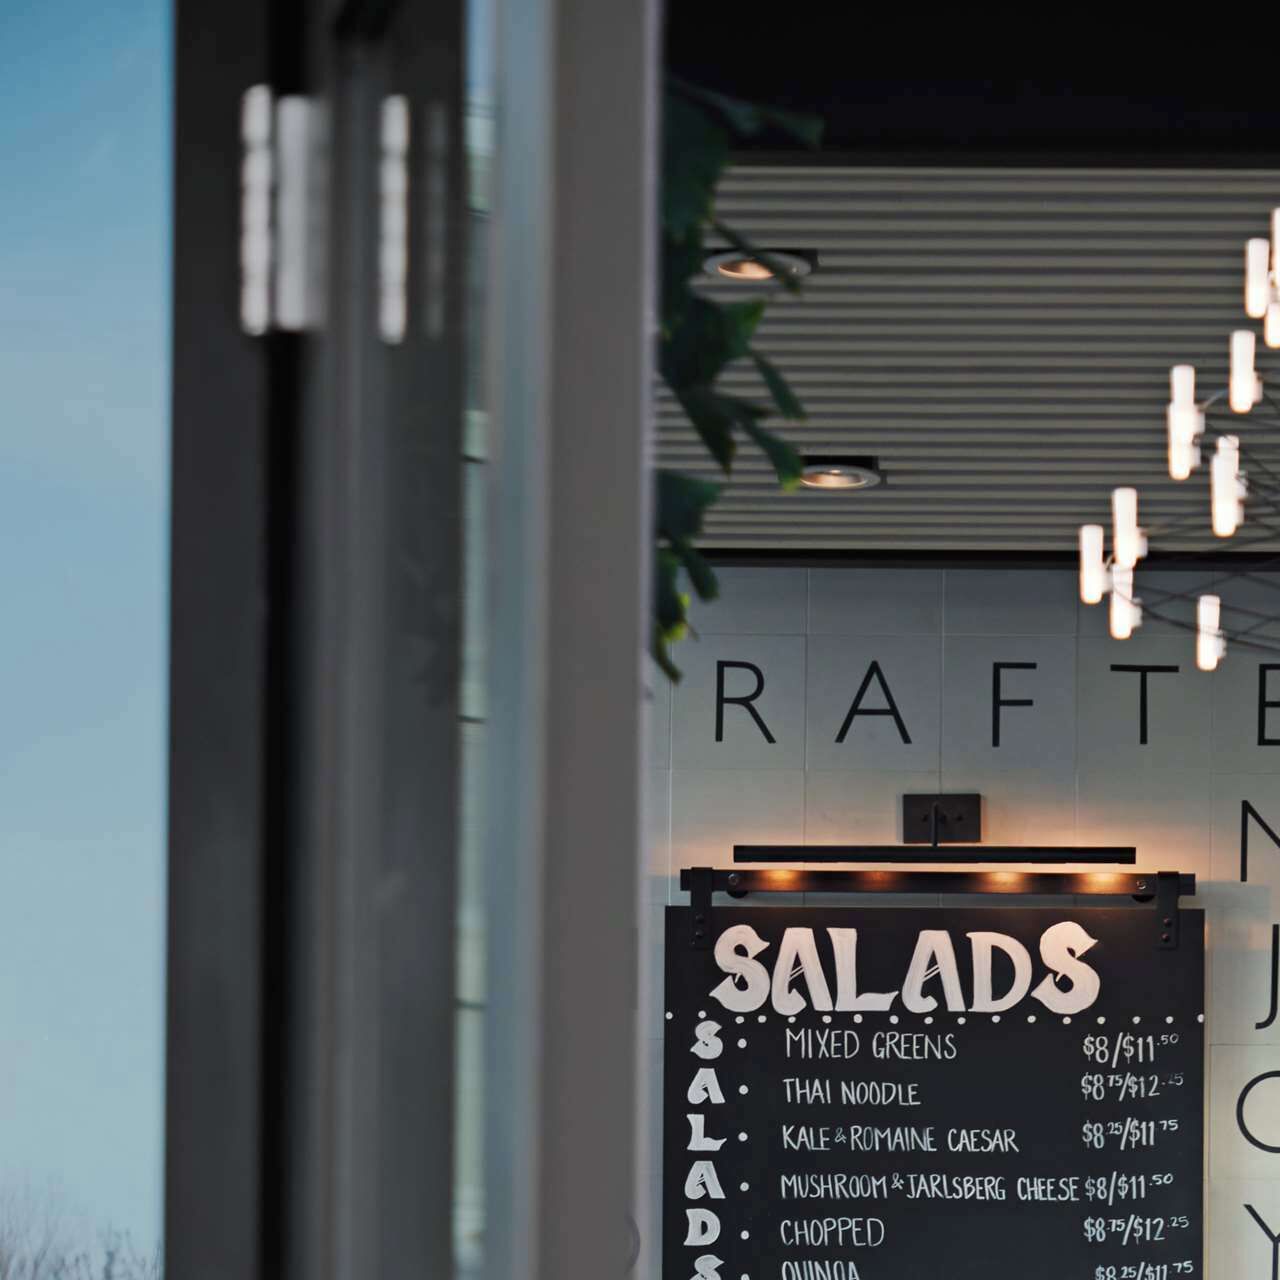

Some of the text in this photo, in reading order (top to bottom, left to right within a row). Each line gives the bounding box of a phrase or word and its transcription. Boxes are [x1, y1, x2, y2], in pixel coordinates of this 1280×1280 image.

[709, 921, 1100, 1016] SALADS
[786, 1028, 957, 1060] MIXED GREENS
[783, 1079, 921, 1105] THAI NOODLE
[782, 1125, 1019, 1153] KALE ROMAINE CAESAR
[780, 1174, 1080, 1201] MUSHROOM JARLSBERG CHEESE
[780, 1218, 885, 1246] CHOPPED
